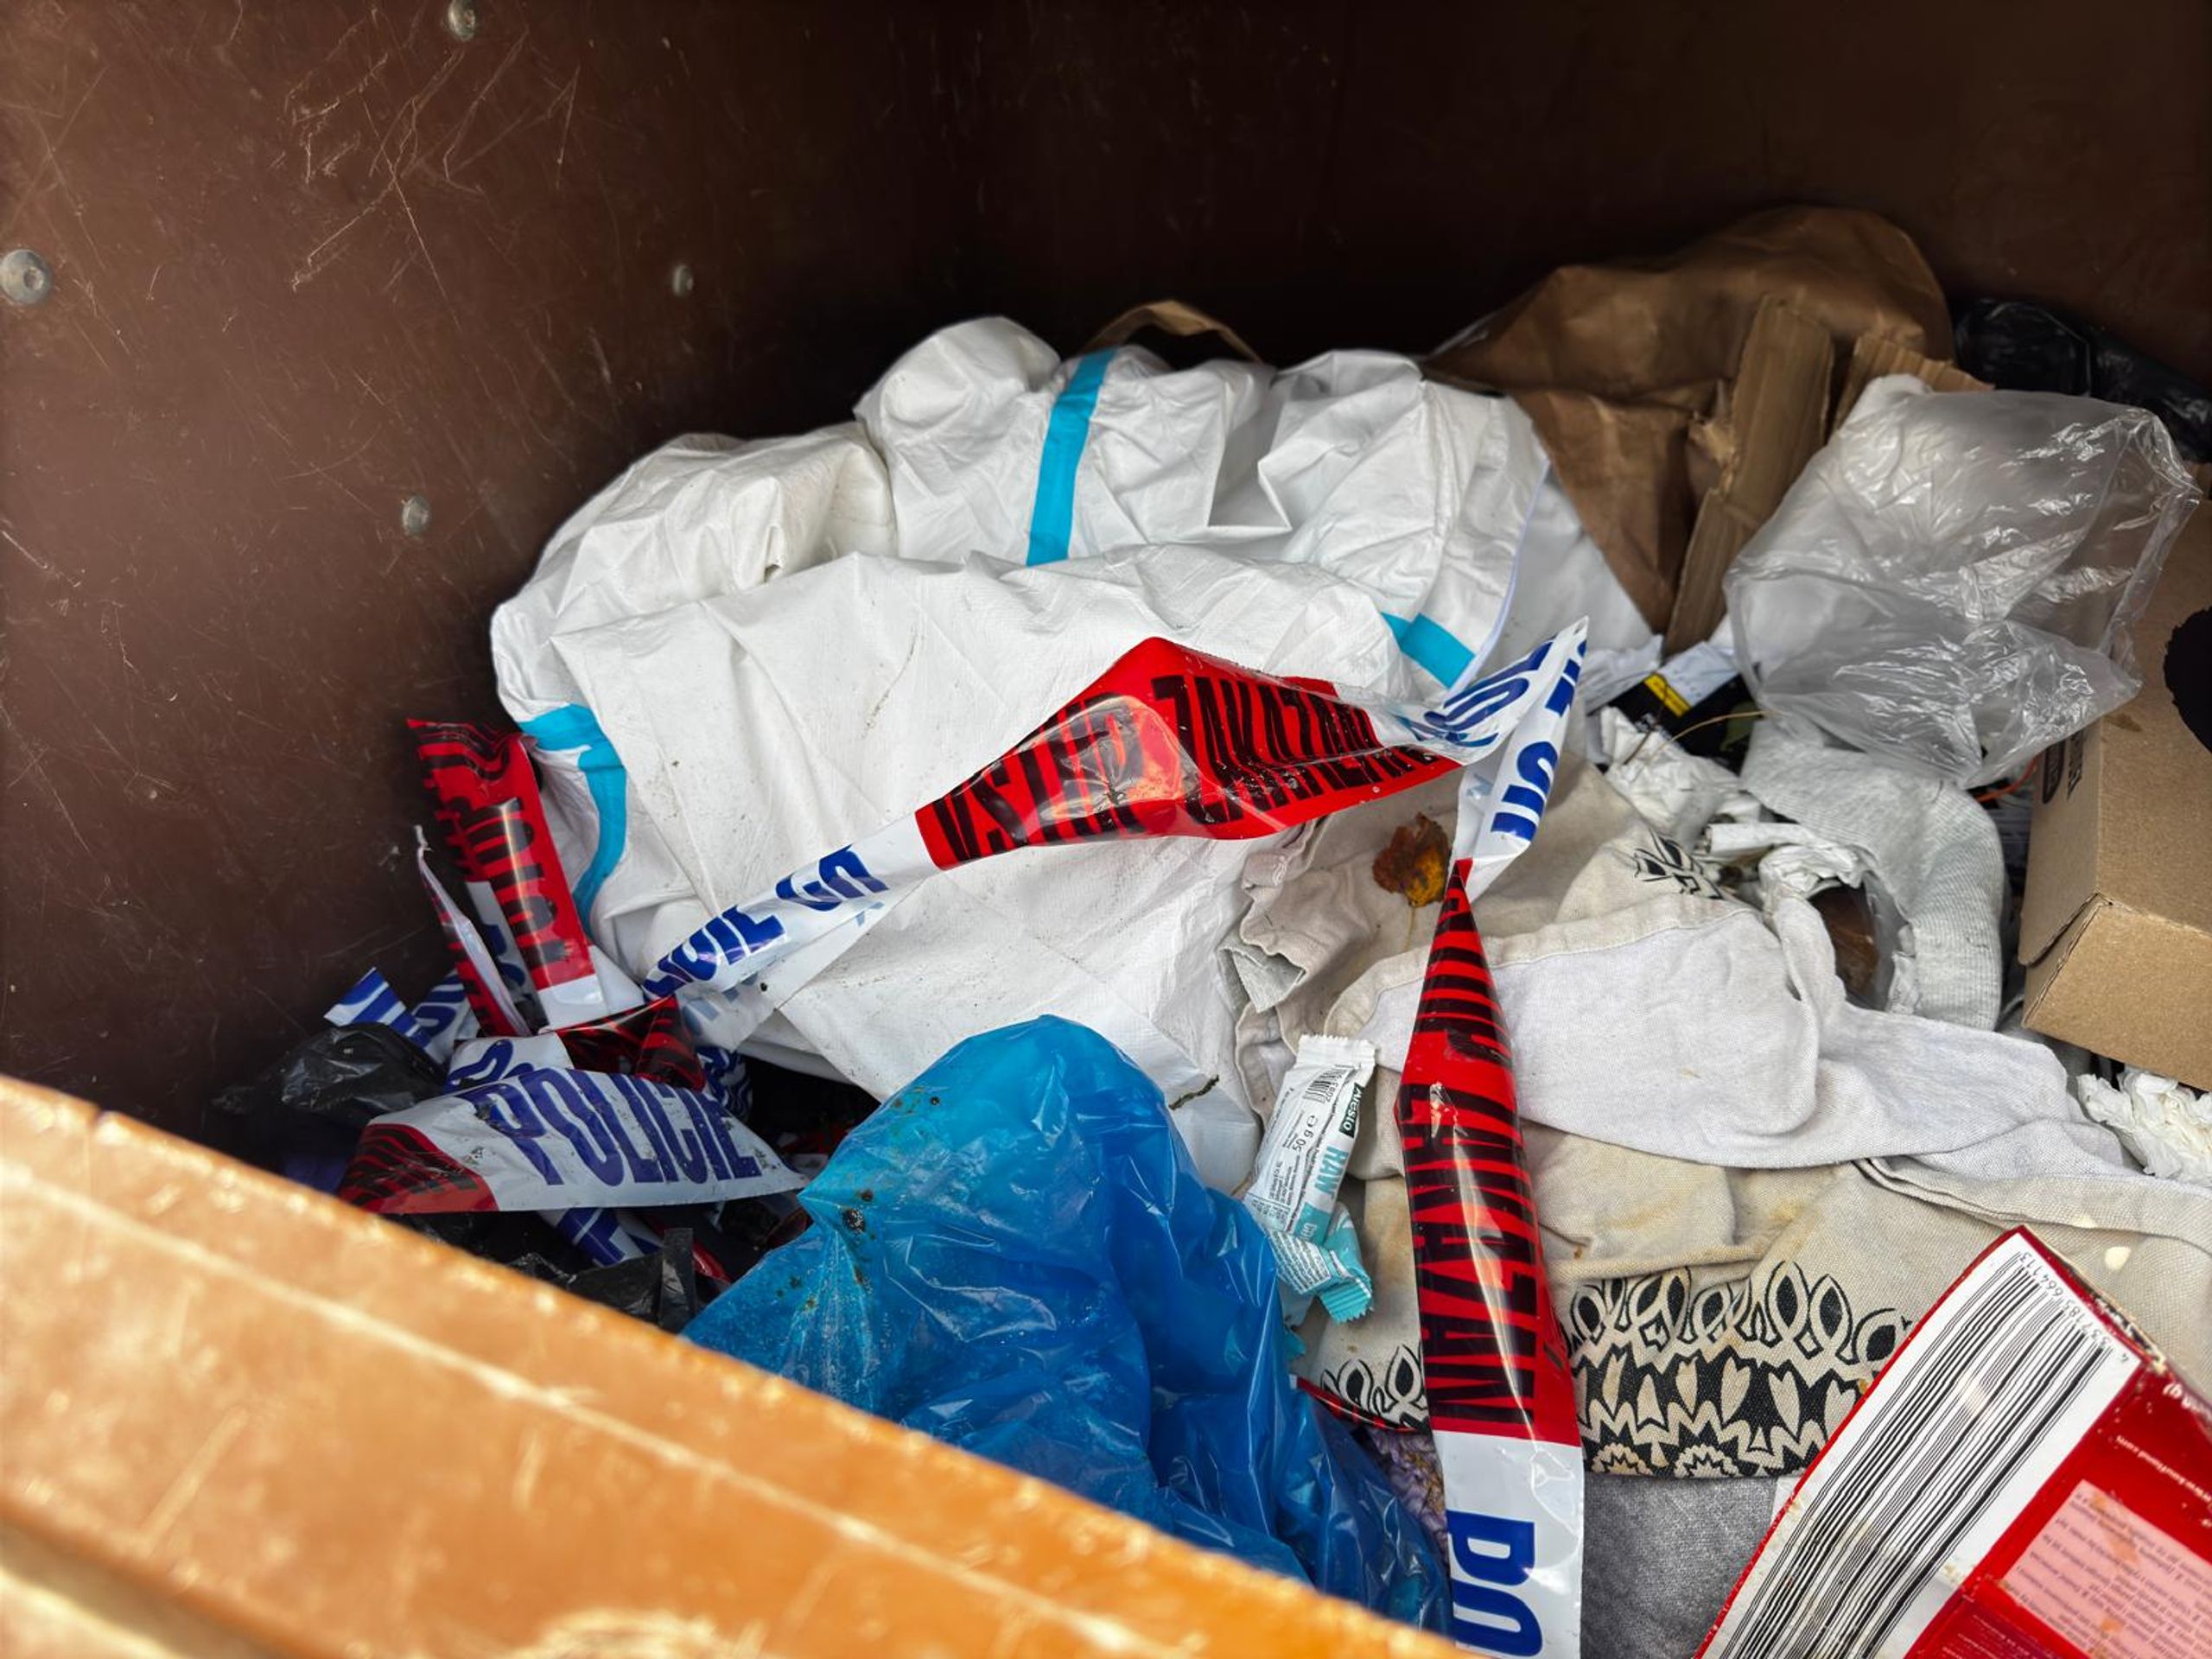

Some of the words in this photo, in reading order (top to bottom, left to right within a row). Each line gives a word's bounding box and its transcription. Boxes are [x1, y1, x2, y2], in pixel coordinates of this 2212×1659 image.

[451, 1067, 762, 1187] POLICIE
[2018, 1251, 2064, 1298] 664113
[2062, 1299, 2113, 1348] 337185
